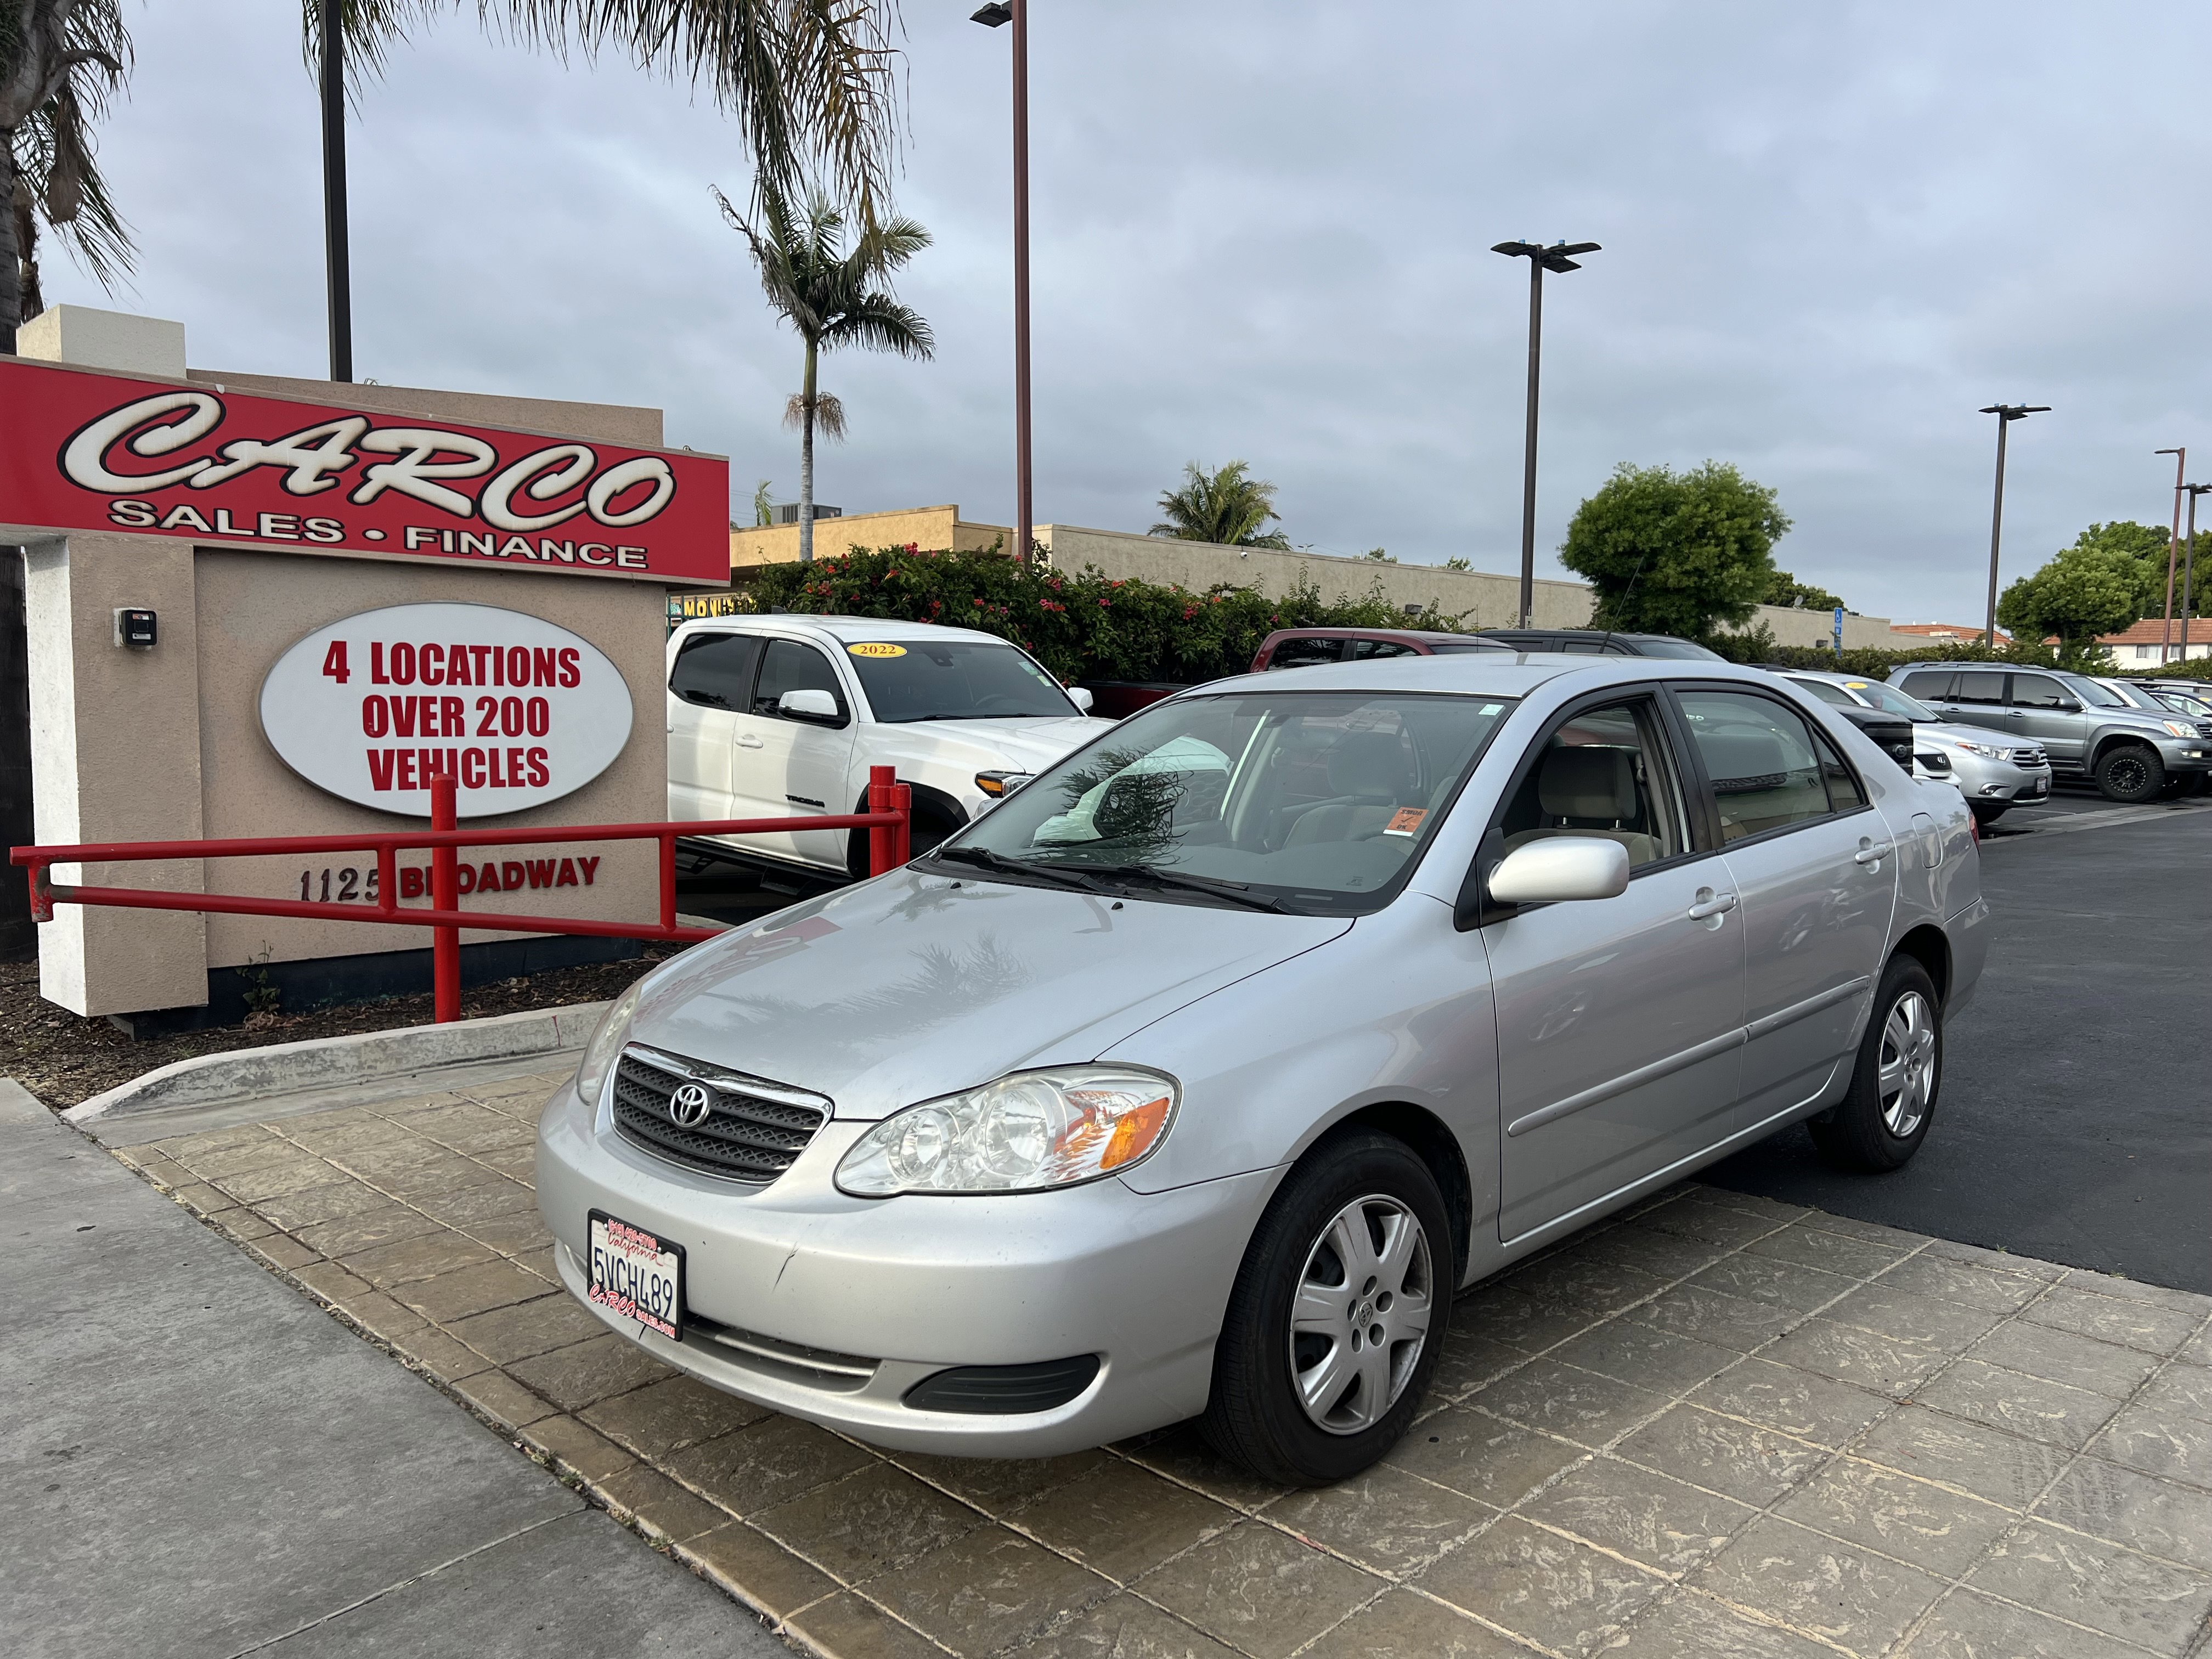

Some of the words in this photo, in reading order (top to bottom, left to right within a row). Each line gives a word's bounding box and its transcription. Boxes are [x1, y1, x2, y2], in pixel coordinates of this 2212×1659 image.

[60, 391, 675, 531] CARCO
[109, 499, 345, 543] SALES
[405, 525, 648, 569] FINANCE
[323, 641, 351, 684] 4
[371, 642, 580, 689] LOCATIONS
[860, 645, 896, 654] 2022
[363, 695, 465, 738] OVER
[476, 696, 550, 737] 200
[367, 747, 550, 791] VEHICLES
[301, 867, 379, 902] 1125
[400, 856, 600, 899] BOADWAY
[608, 1232, 664, 1267] California
[595, 1246, 673, 1318] 5VCH489
